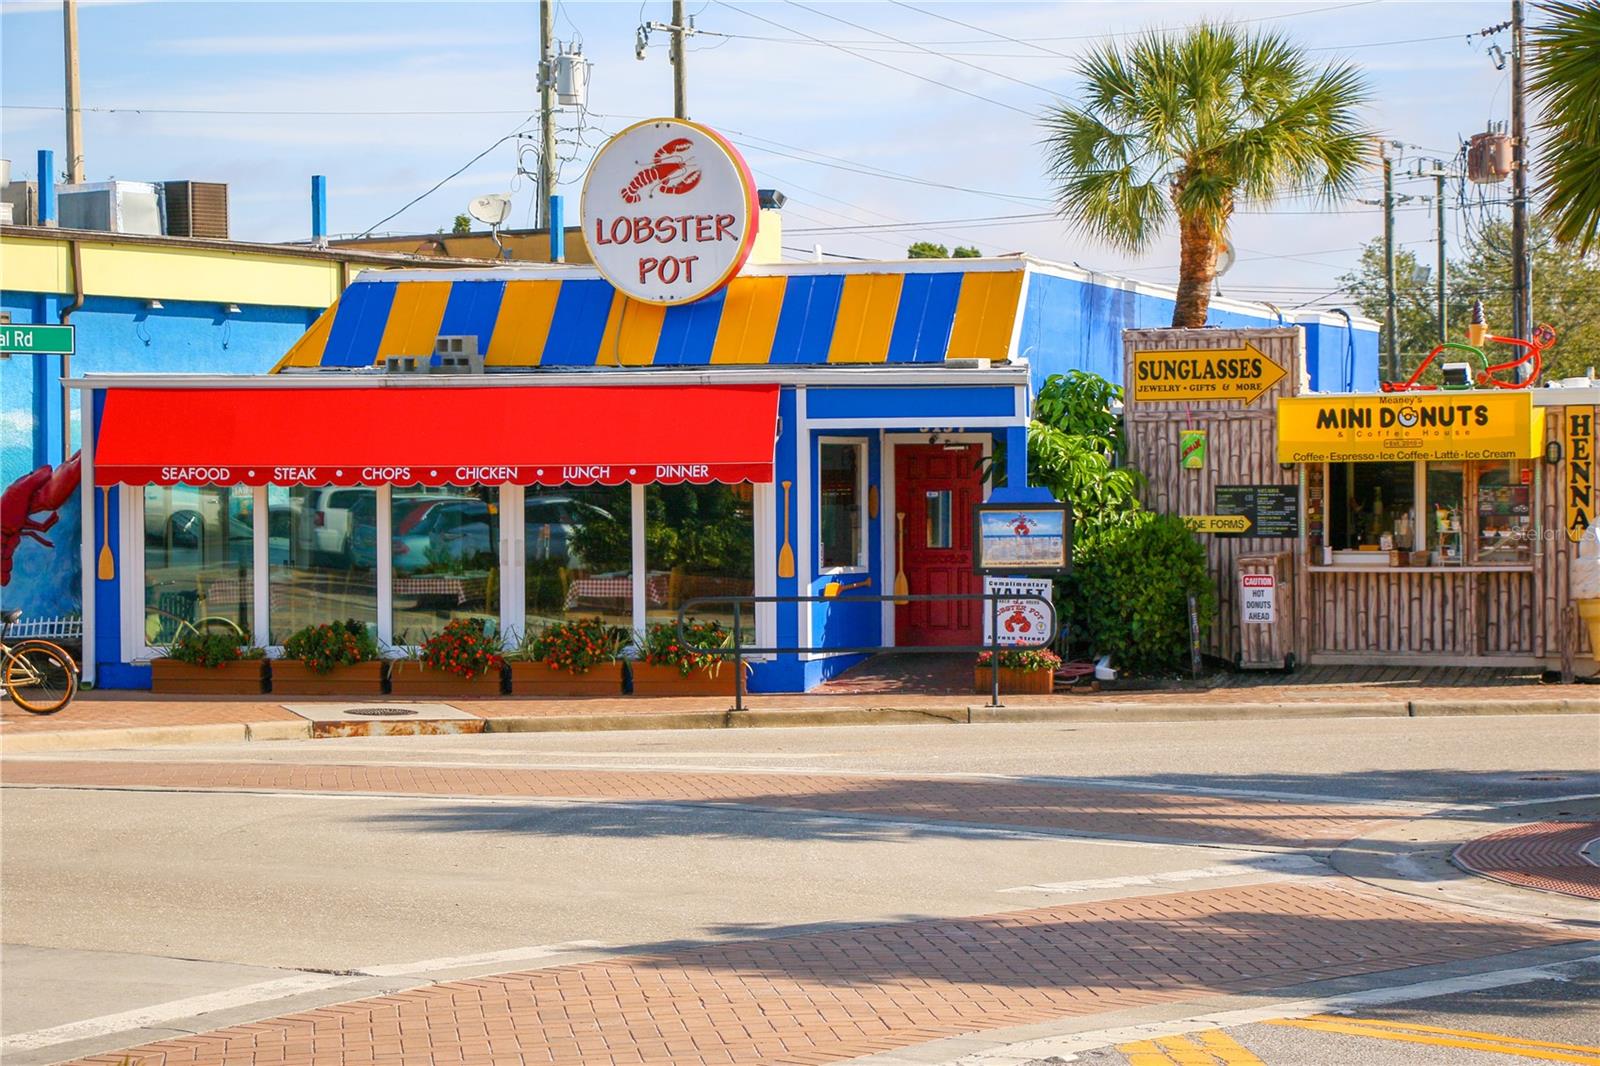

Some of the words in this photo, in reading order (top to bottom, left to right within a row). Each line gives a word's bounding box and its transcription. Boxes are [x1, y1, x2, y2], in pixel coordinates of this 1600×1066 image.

[596, 214, 739, 245] LOBSTER
[638, 255, 699, 284] POT
[14, 331, 33, 347] Rd
[1138, 358, 1263, 381] SUNGLASSES
[1138, 384, 1182, 393] JEWELRY
[1189, 383, 1217, 392] GIFTS
[1236, 382, 1263, 391] MORE
[1379, 396, 1423, 405] Meaney's
[1316, 408, 1372, 429] MINI
[1380, 405, 1489, 428] DONUTS
[1356, 430, 1410, 438] Coffee
[1422, 429, 1471, 437] House
[1293, 452, 1325, 461] Coffee
[1329, 451, 1375, 463] Espresso
[1380, 451, 1396, 460] Ice
[1398, 450, 1429, 460] Coffee
[1465, 449, 1481, 459] Ice
[1483, 449, 1516, 459] Cream
[161, 467, 230, 480] SEAFOOD
[274, 467, 317, 480] STEAK
[362, 467, 411, 480] CHOPS
[456, 466, 518, 480] CHICKEN
[563, 466, 610, 479] LUNCH
[656, 465, 709, 478] DINNER
[1569, 414, 1591, 530] HENNA
[1210, 519, 1245, 529] FORMS
[1252, 589, 1265, 598] HOT
[1246, 600, 1272, 609] DONUTS
[1248, 612, 1270, 620] AHEAD
